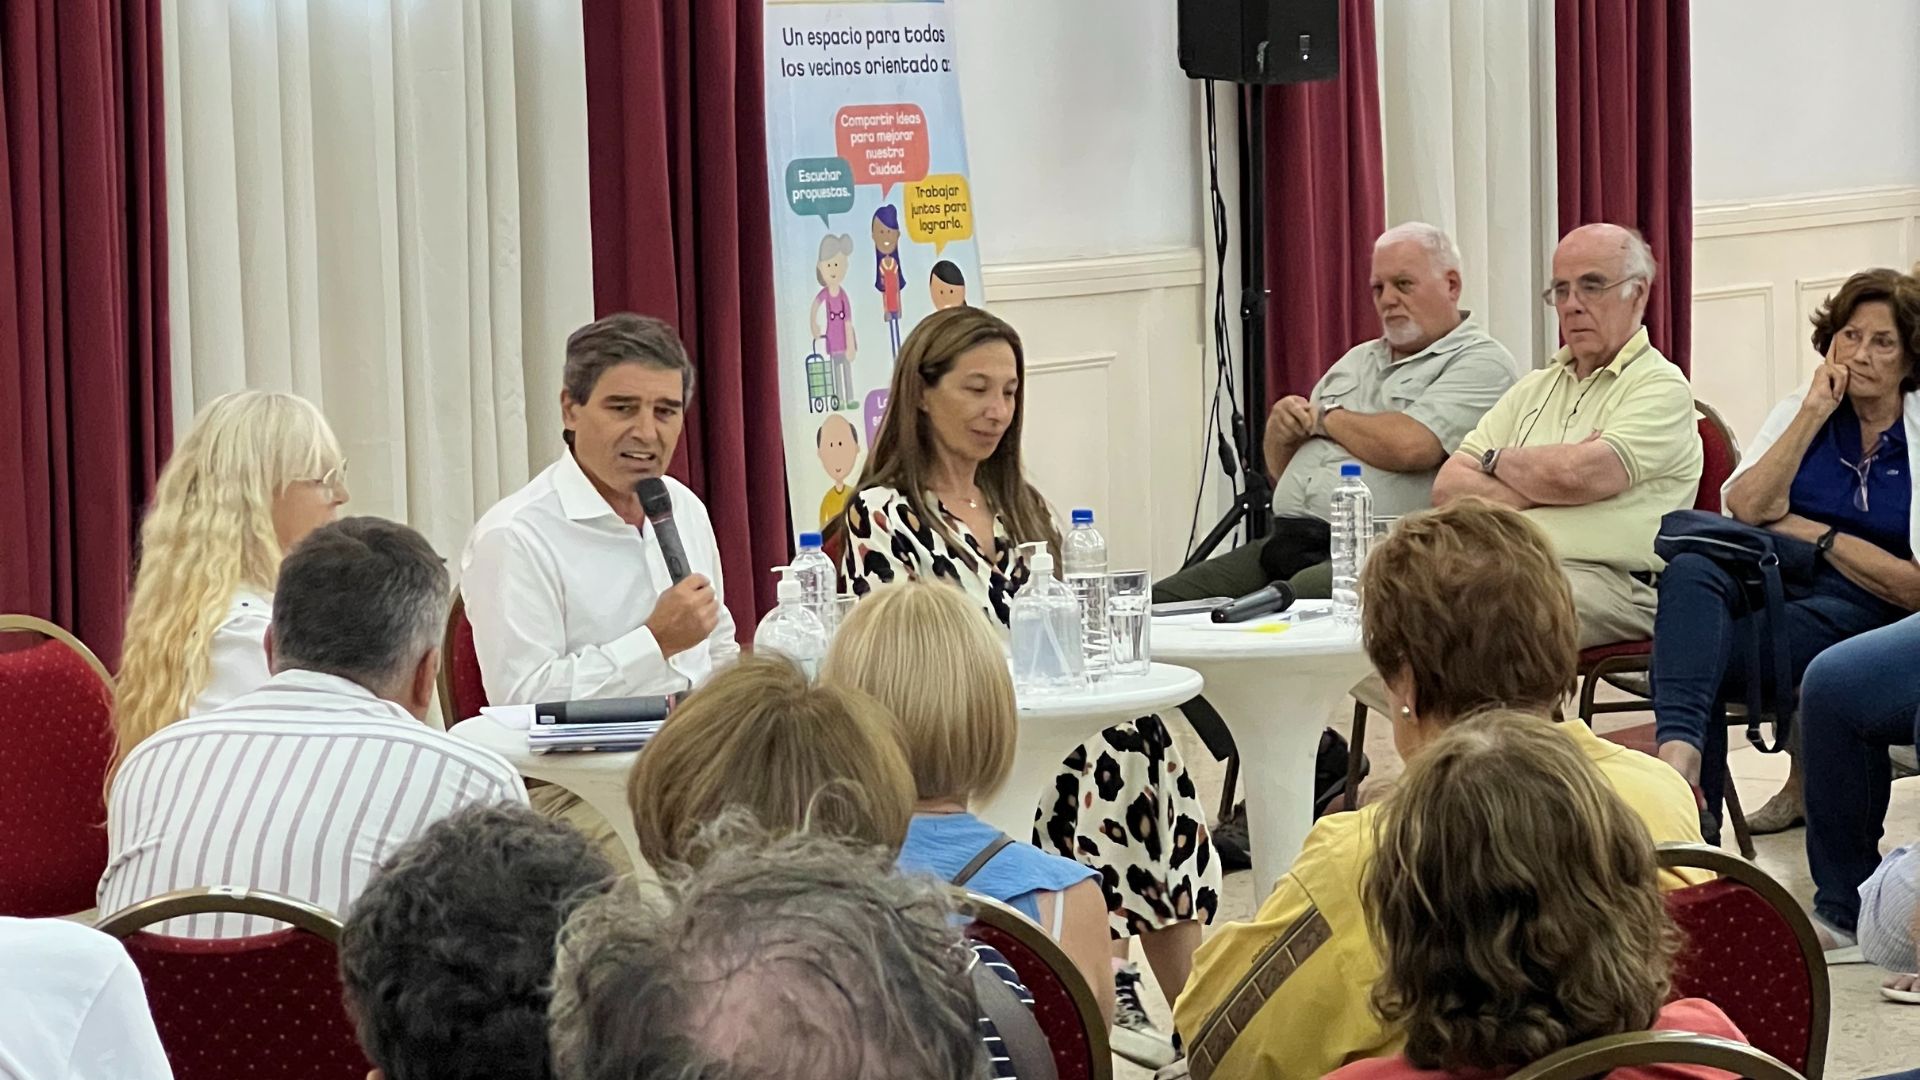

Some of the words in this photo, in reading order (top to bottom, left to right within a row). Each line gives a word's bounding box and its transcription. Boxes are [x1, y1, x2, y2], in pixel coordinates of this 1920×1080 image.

[782, 27, 804, 46] Un
[807, 26, 862, 51] espacio
[866, 30, 900, 50] para
[904, 23, 945, 43] todos
[781, 57, 805, 77] los
[808, 57, 862, 76] vecinos
[865, 54, 938, 74] orientado
[841, 113, 894, 130] Compartir
[896, 112, 921, 125] ideas
[850, 132, 875, 147] para
[876, 129, 914, 145] mejorar
[865, 146, 905, 160] nuestra
[798, 168, 842, 183] Escuchar
[869, 161, 905, 176] Ciudad.
[792, 187, 851, 204] propuestas.
[915, 184, 960, 201] Trabajar
[911, 203, 941, 219] juntos
[943, 203, 967, 217] para
[919, 216, 963, 235] lograrlo.
